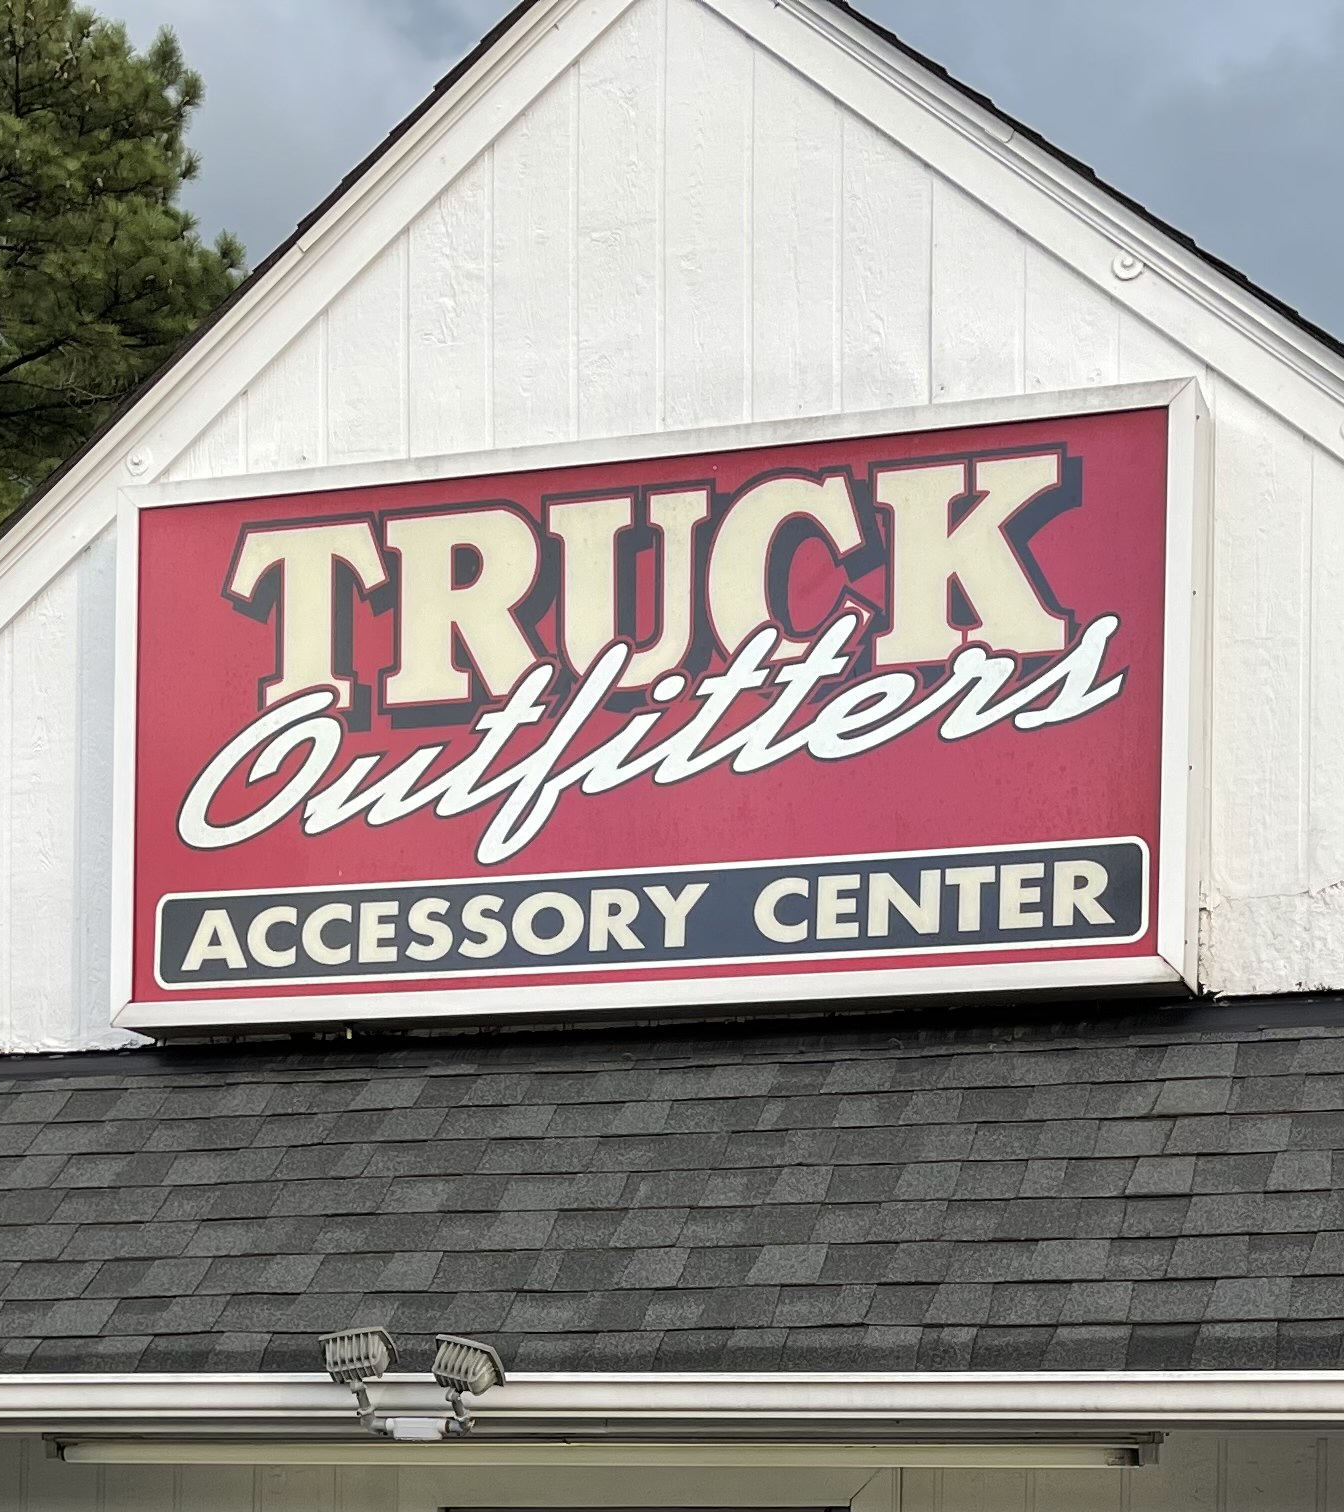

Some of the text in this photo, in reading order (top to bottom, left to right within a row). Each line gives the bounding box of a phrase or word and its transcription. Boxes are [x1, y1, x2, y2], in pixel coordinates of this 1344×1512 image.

[228, 445, 1081, 725] TRUCK
[178, 613, 1124, 865] Outfitters
[181, 859, 1115, 972] ACCESSORY CENTER
